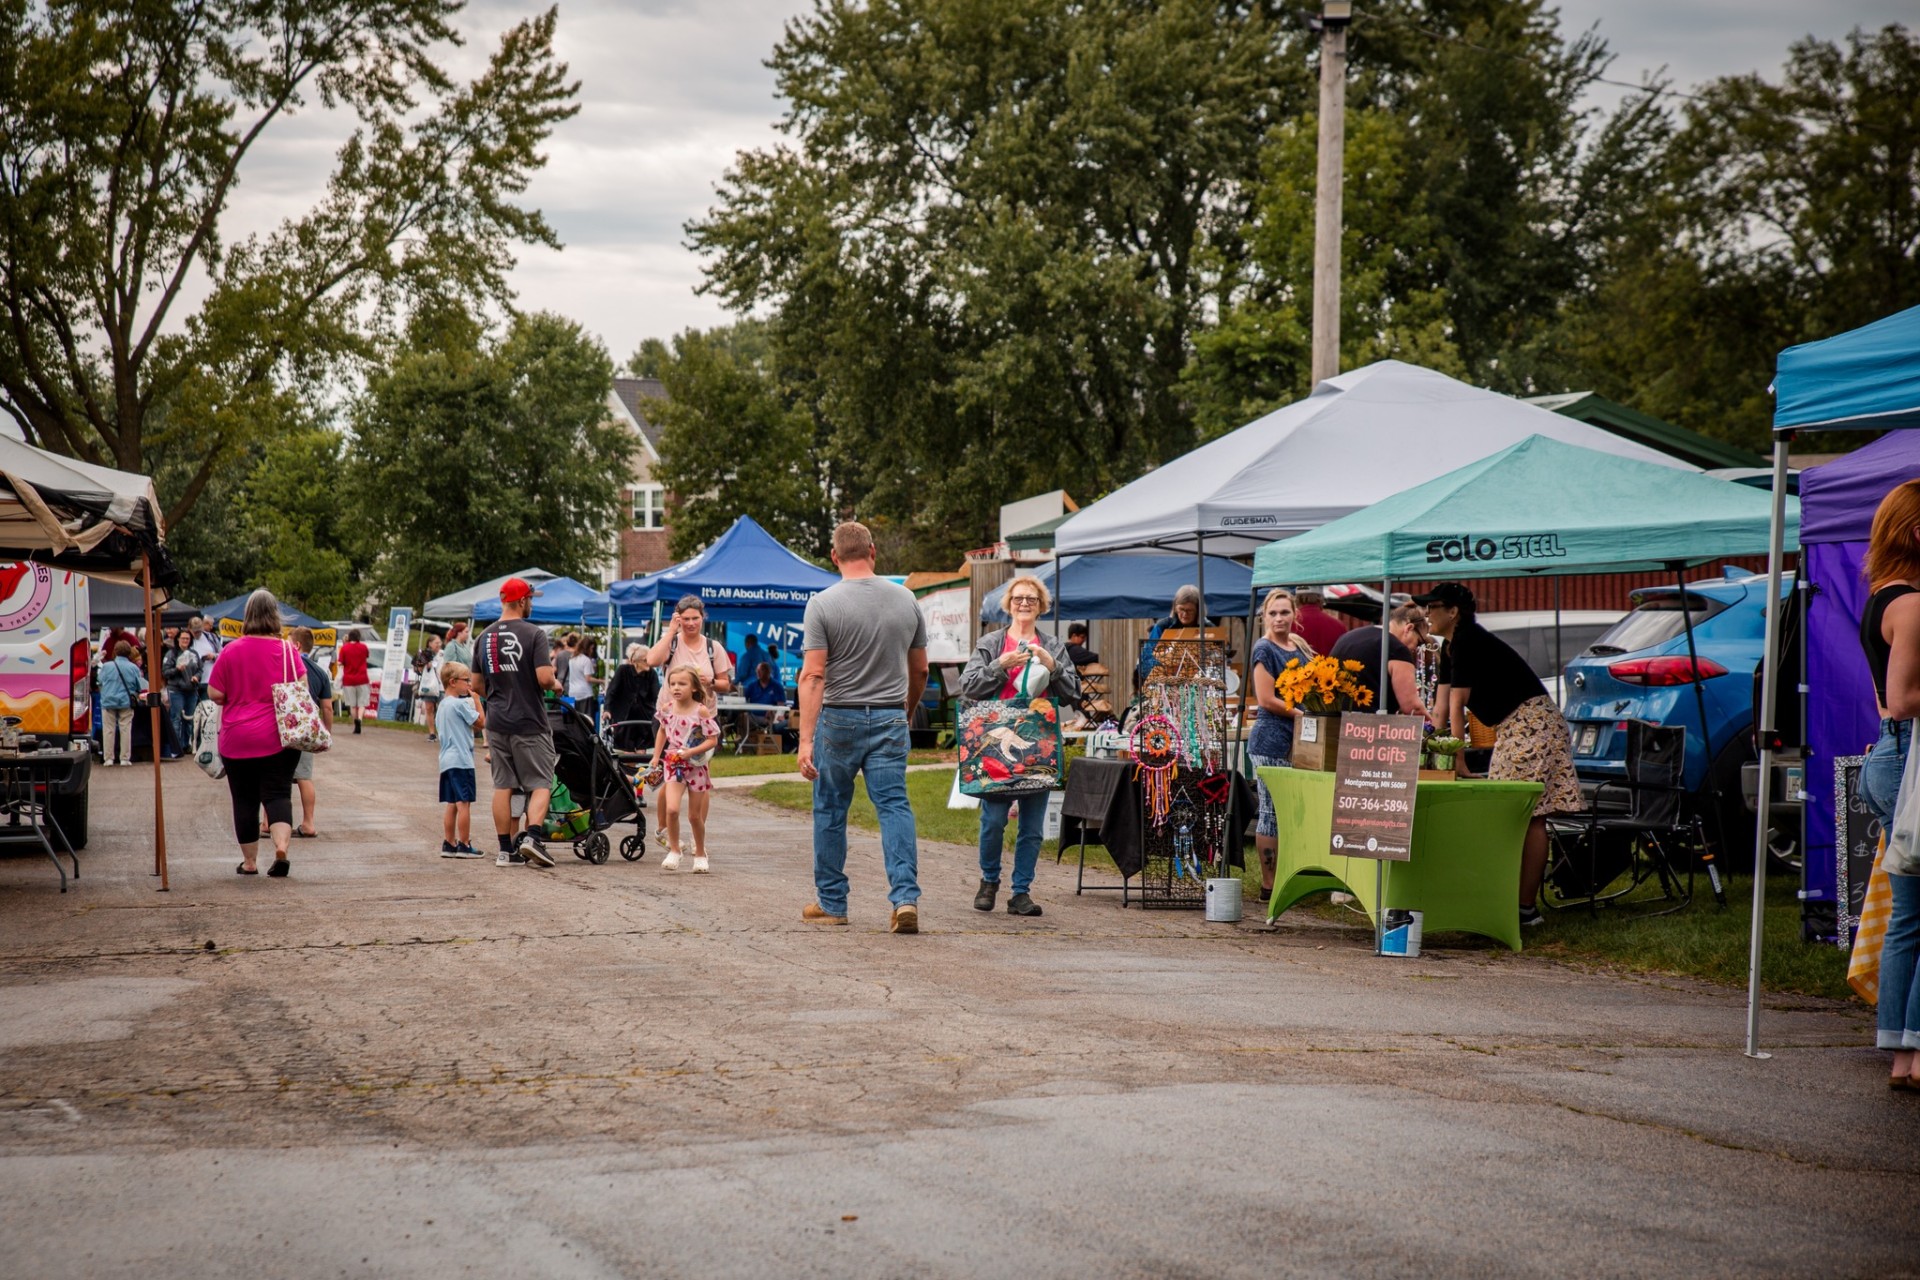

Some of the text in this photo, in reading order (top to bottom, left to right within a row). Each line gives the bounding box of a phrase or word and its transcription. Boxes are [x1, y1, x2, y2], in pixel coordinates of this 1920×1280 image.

[1502, 533, 1567, 560] STEEL
[701, 587, 717, 598] It's
[718, 588, 732, 598] All
[732, 588, 764, 599] About
[765, 589, 789, 600] How
[790, 590, 808, 601] You
[10, 601, 42, 627] TREATS
[1345, 722, 1416, 743] Posy Floral
[1350, 746, 1407, 766] and Gifts
[1361, 770, 1372, 778] 206
[1380, 780, 1390, 788] MN
[1338, 796, 1408, 812] 507-364-5894
